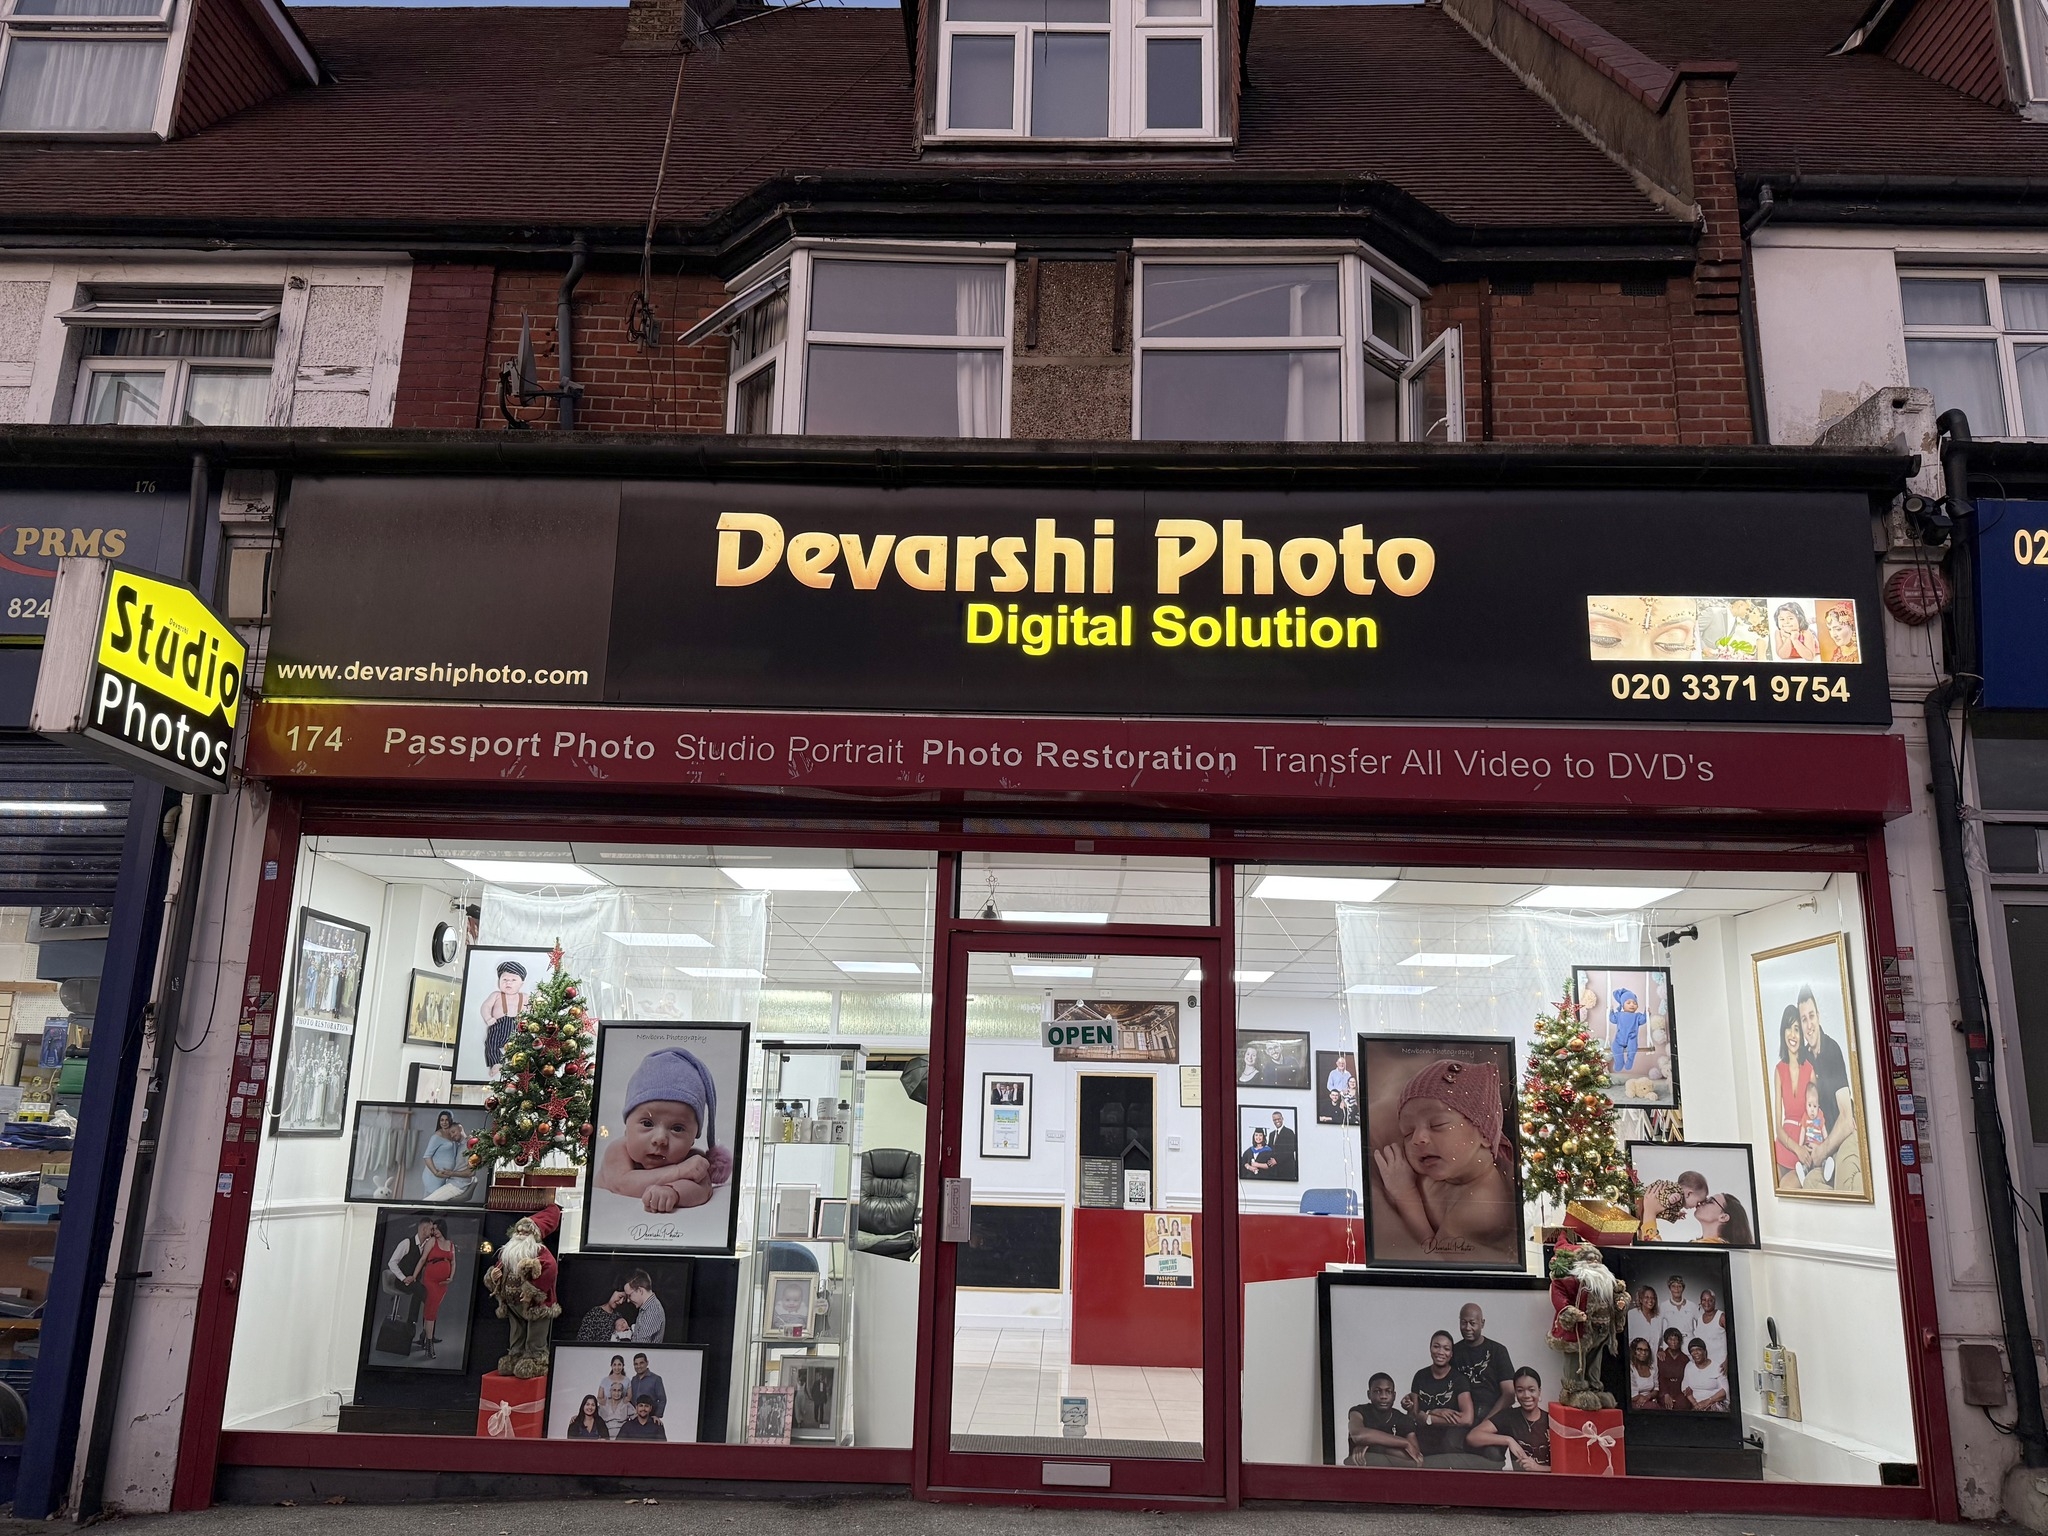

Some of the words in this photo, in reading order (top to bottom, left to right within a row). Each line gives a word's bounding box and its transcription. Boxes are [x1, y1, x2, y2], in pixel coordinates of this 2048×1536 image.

[135, 480, 156, 494] 176
[13, 527, 127, 557] PRMS
[716, 513, 1113, 594] Devarshi
[1155, 519, 1435, 597] Photo
[2014, 529, 2048, 565] 02
[7, 597, 50, 619] 824
[967, 603, 1132, 656] Digital
[1152, 605, 1378, 649] Solution
[110, 584, 240, 708] Studio
[277, 660, 588, 687] www.devarshiphoto.com
[1611, 673, 1670, 700] 020
[1682, 674, 1757, 701] 3371
[1771, 676, 1851, 703] 9754
[97, 672, 228, 776] Photos
[286, 725, 343, 752] 174
[384, 728, 541, 763] Passport
[553, 731, 655, 760] Photo
[675, 734, 775, 761] Studio
[788, 736, 904, 764] Portrait
[922, 739, 1023, 766] Photo
[1036, 742, 1236, 771] Restoration
[1254, 746, 1392, 775] Transfer
[1401, 749, 1441, 776] All
[1454, 749, 1551, 778] Video
[1564, 752, 1595, 779] to
[1608, 752, 1714, 781] DVD's
[296, 1017, 314, 1026] PHOTO
[315, 1020, 348, 1031] RESTORATION
[1048, 1025, 1113, 1046] OPEN
[666, 1034, 707, 1044] Photography
[1401, 1047, 1431, 1055] Newborn
[1432, 1047, 1475, 1059] Photography
